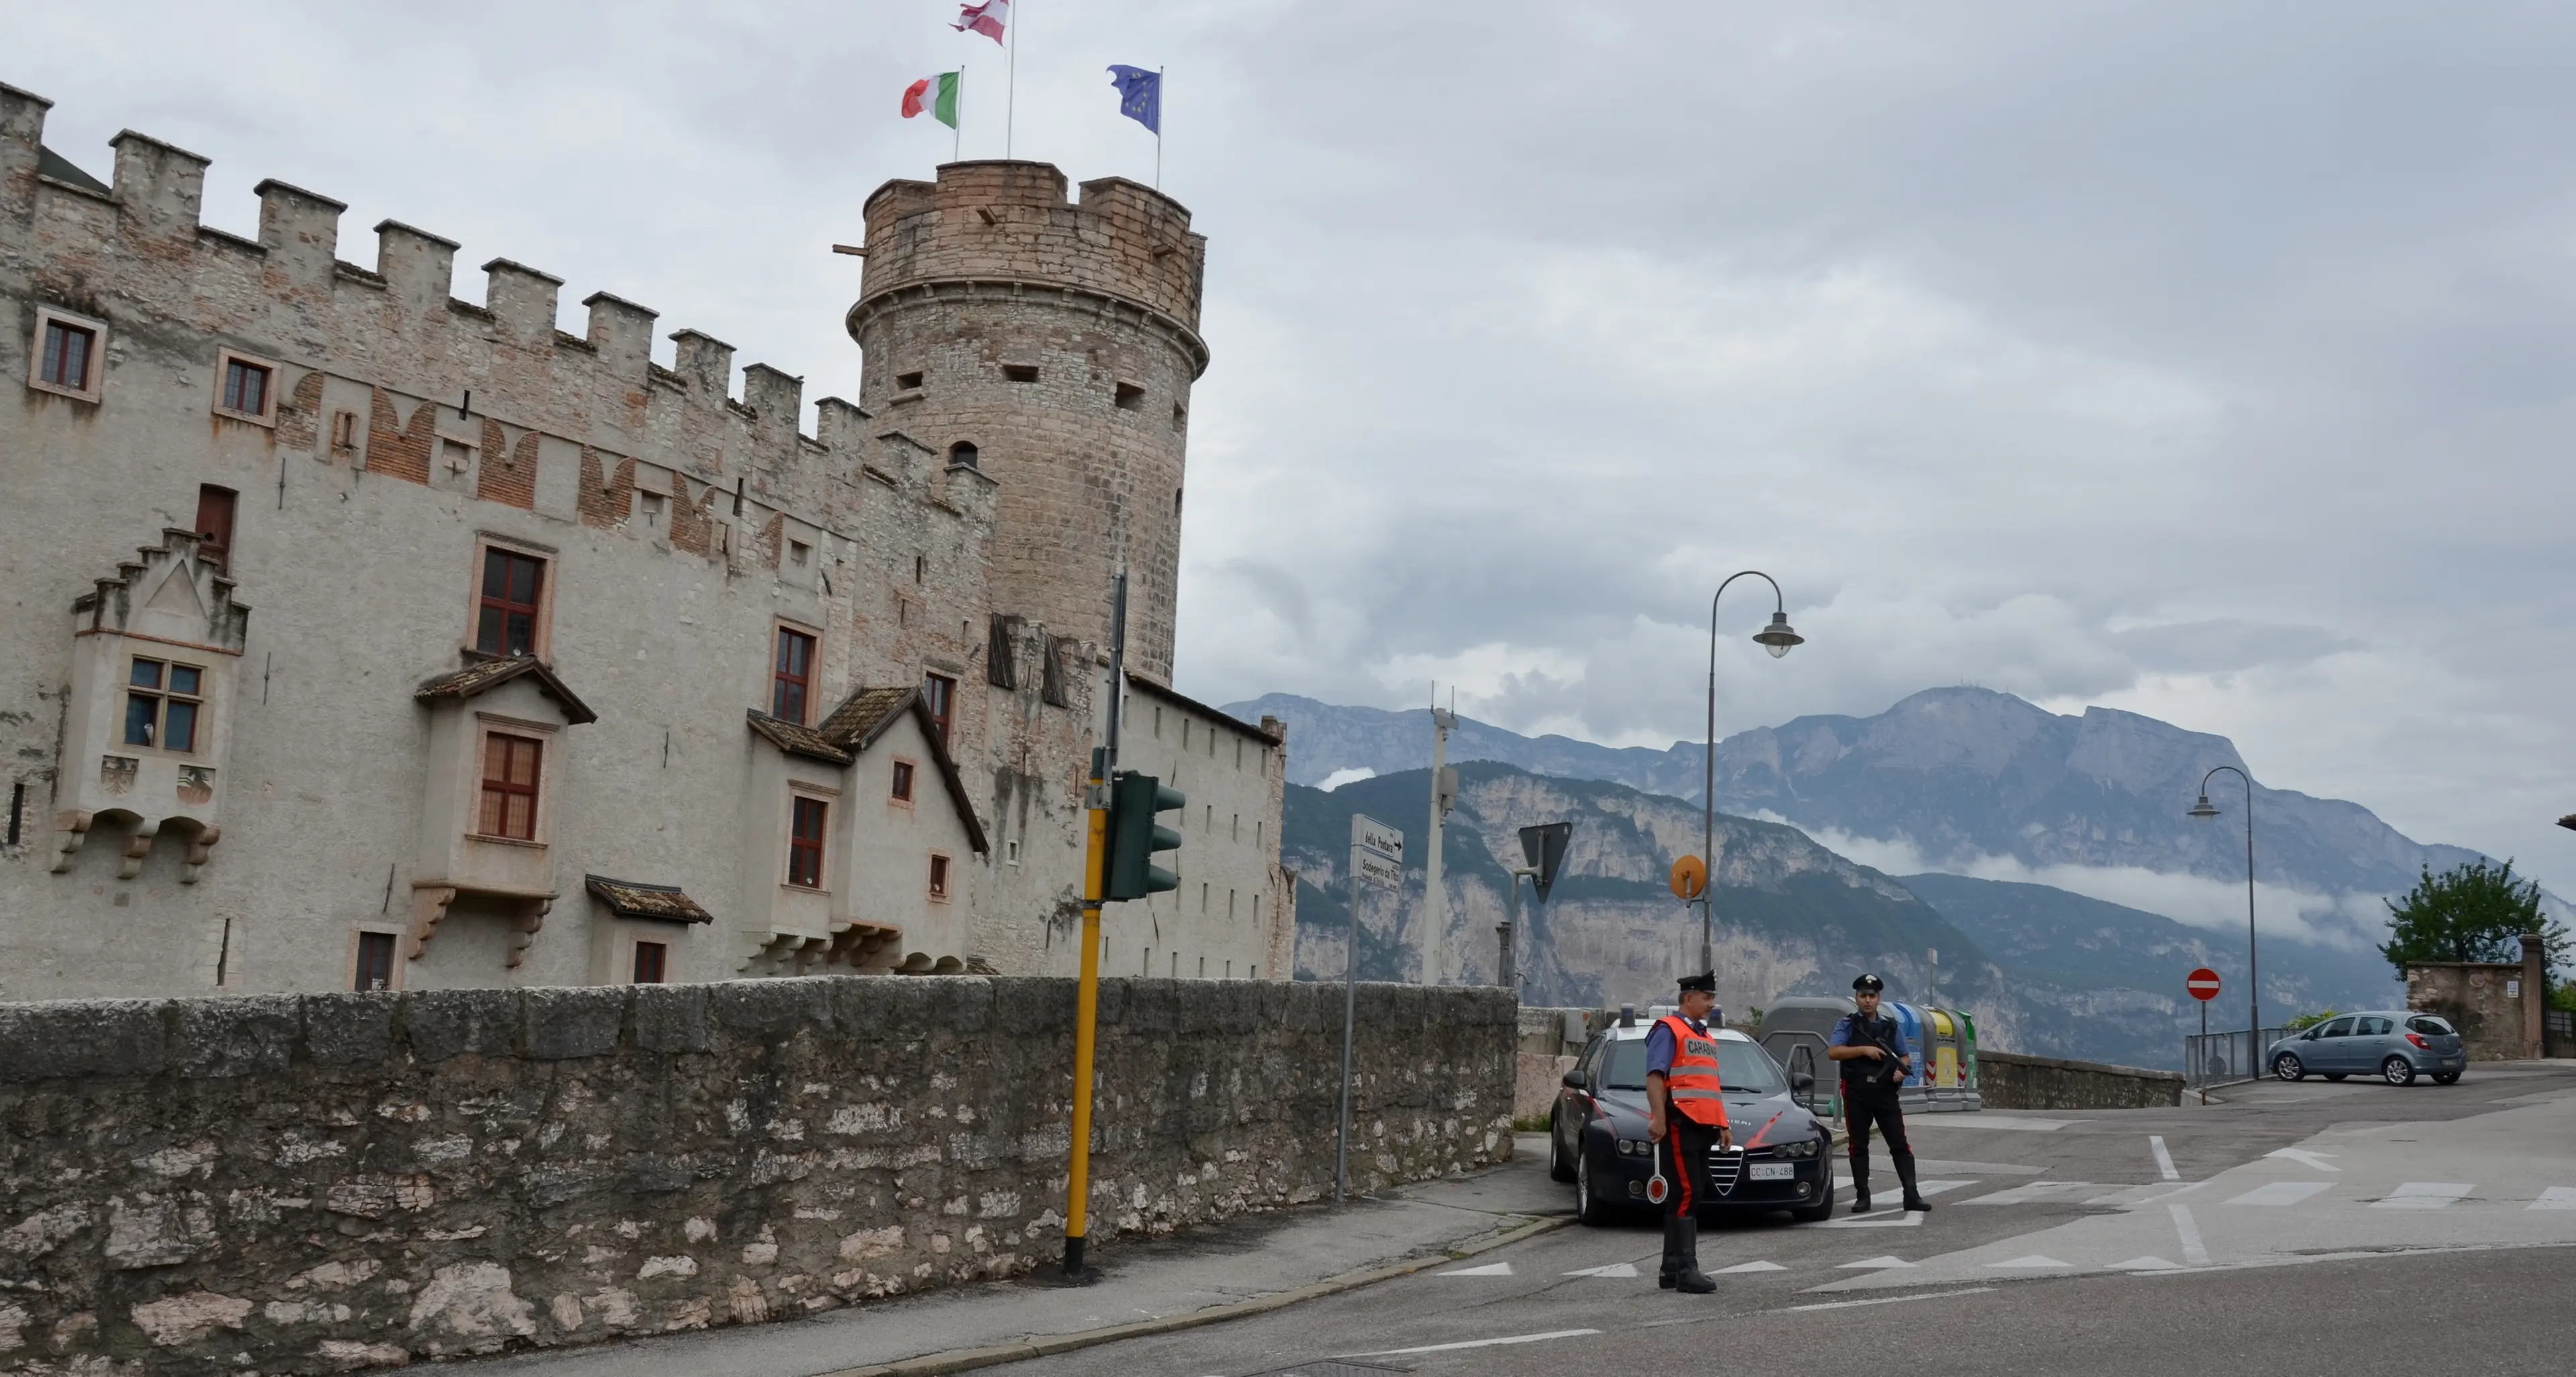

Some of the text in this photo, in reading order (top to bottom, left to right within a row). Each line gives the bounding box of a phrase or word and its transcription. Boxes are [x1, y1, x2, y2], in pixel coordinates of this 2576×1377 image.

[1365, 831, 1376, 846] della
[1385, 868, 1390, 879] da
[1751, 1167, 1761, 1176] CC
[1779, 1166, 1793, 1176] 488
